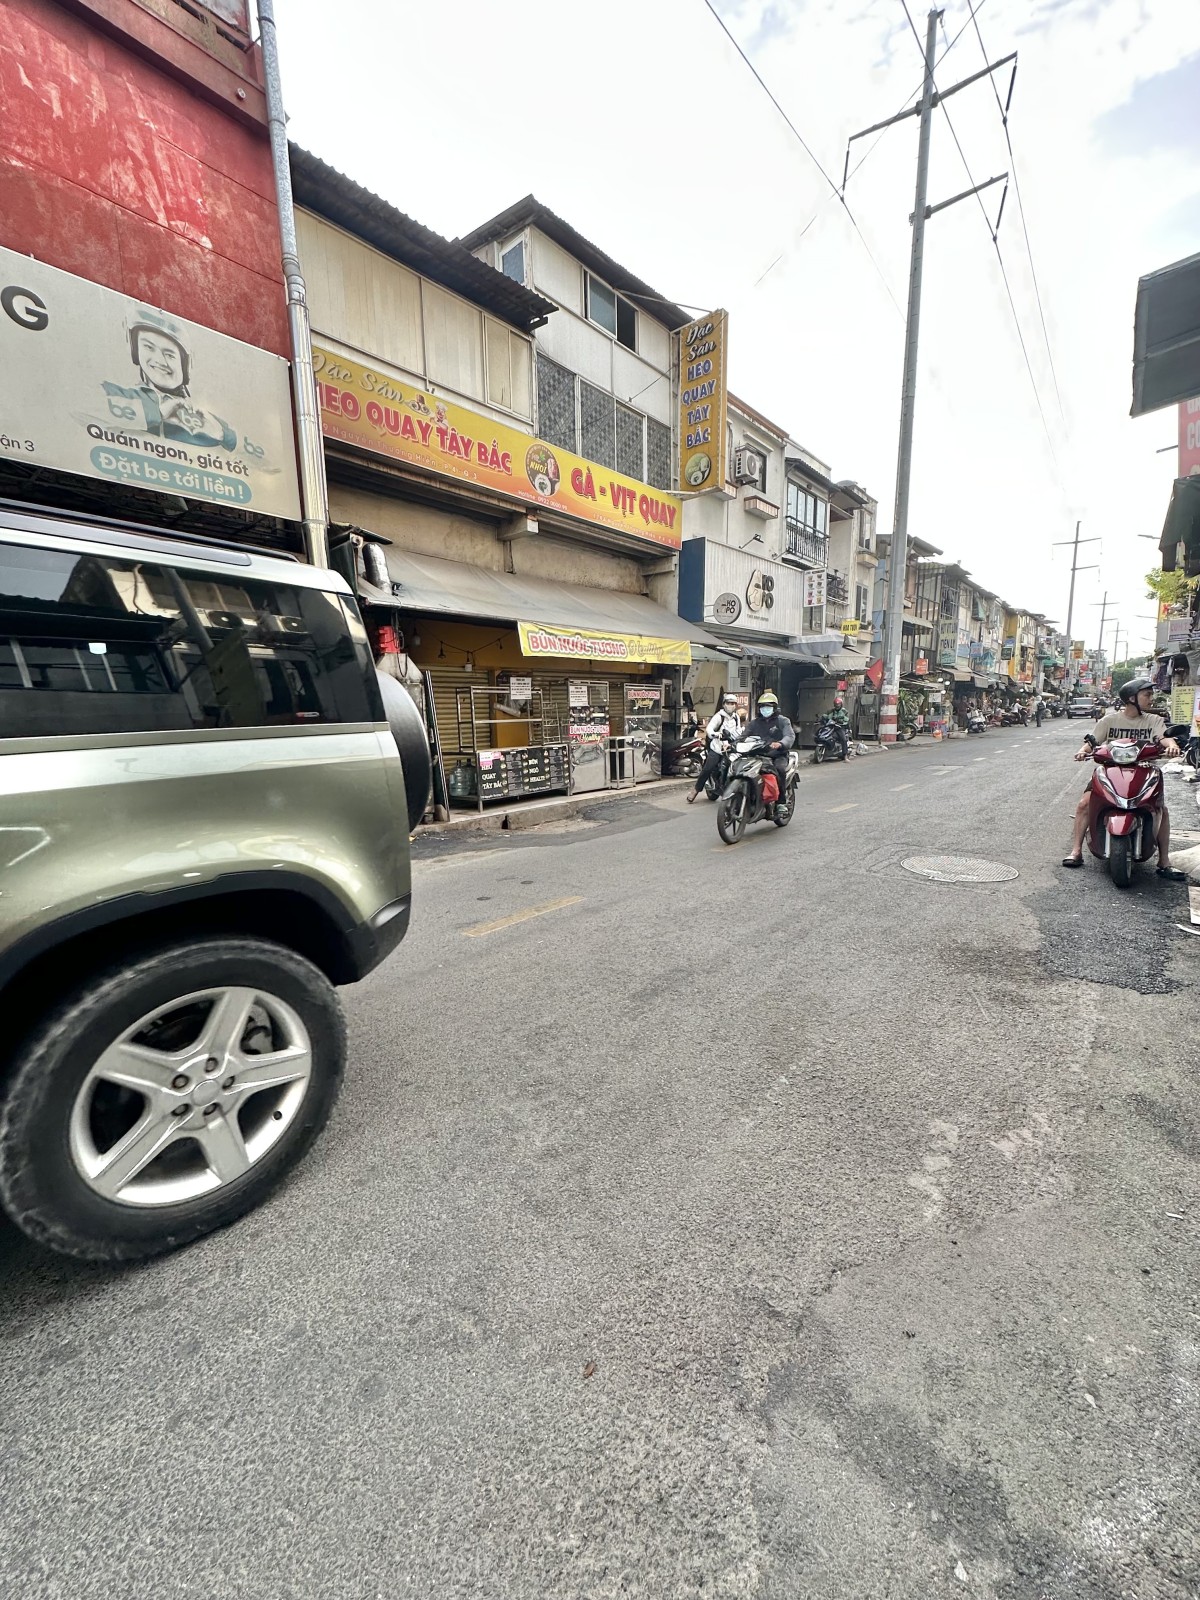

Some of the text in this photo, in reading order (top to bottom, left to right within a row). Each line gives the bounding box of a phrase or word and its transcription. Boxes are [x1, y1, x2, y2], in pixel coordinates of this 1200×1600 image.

[0, 286, 49, 331] G
[686, 359, 712, 382] HEO
[682, 379, 716, 407] QUAY
[108, 398, 137, 421] be
[687, 404, 711, 425] TÂY
[0, 434, 35, 452] ận 3
[243, 436, 265, 458] be
[365, 400, 433, 447] QUAY
[436, 425, 475, 463] TÂY
[477, 439, 513, 477] BẮC
[685, 424, 711, 449] BẮC
[86, 423, 249, 477] Quán ngon, giá tốt
[99, 452, 141, 479] Đặt
[144, 462, 170, 482] be
[173, 471, 200, 490] tới
[203, 476, 235, 498] liền
[571, 466, 597, 502] GÀ
[609, 481, 637, 517] VỊT
[638, 494, 677, 529] QUAY
[529, 631, 558, 651] BÚN
[1108, 727, 1153, 739] BUTTERFLY
